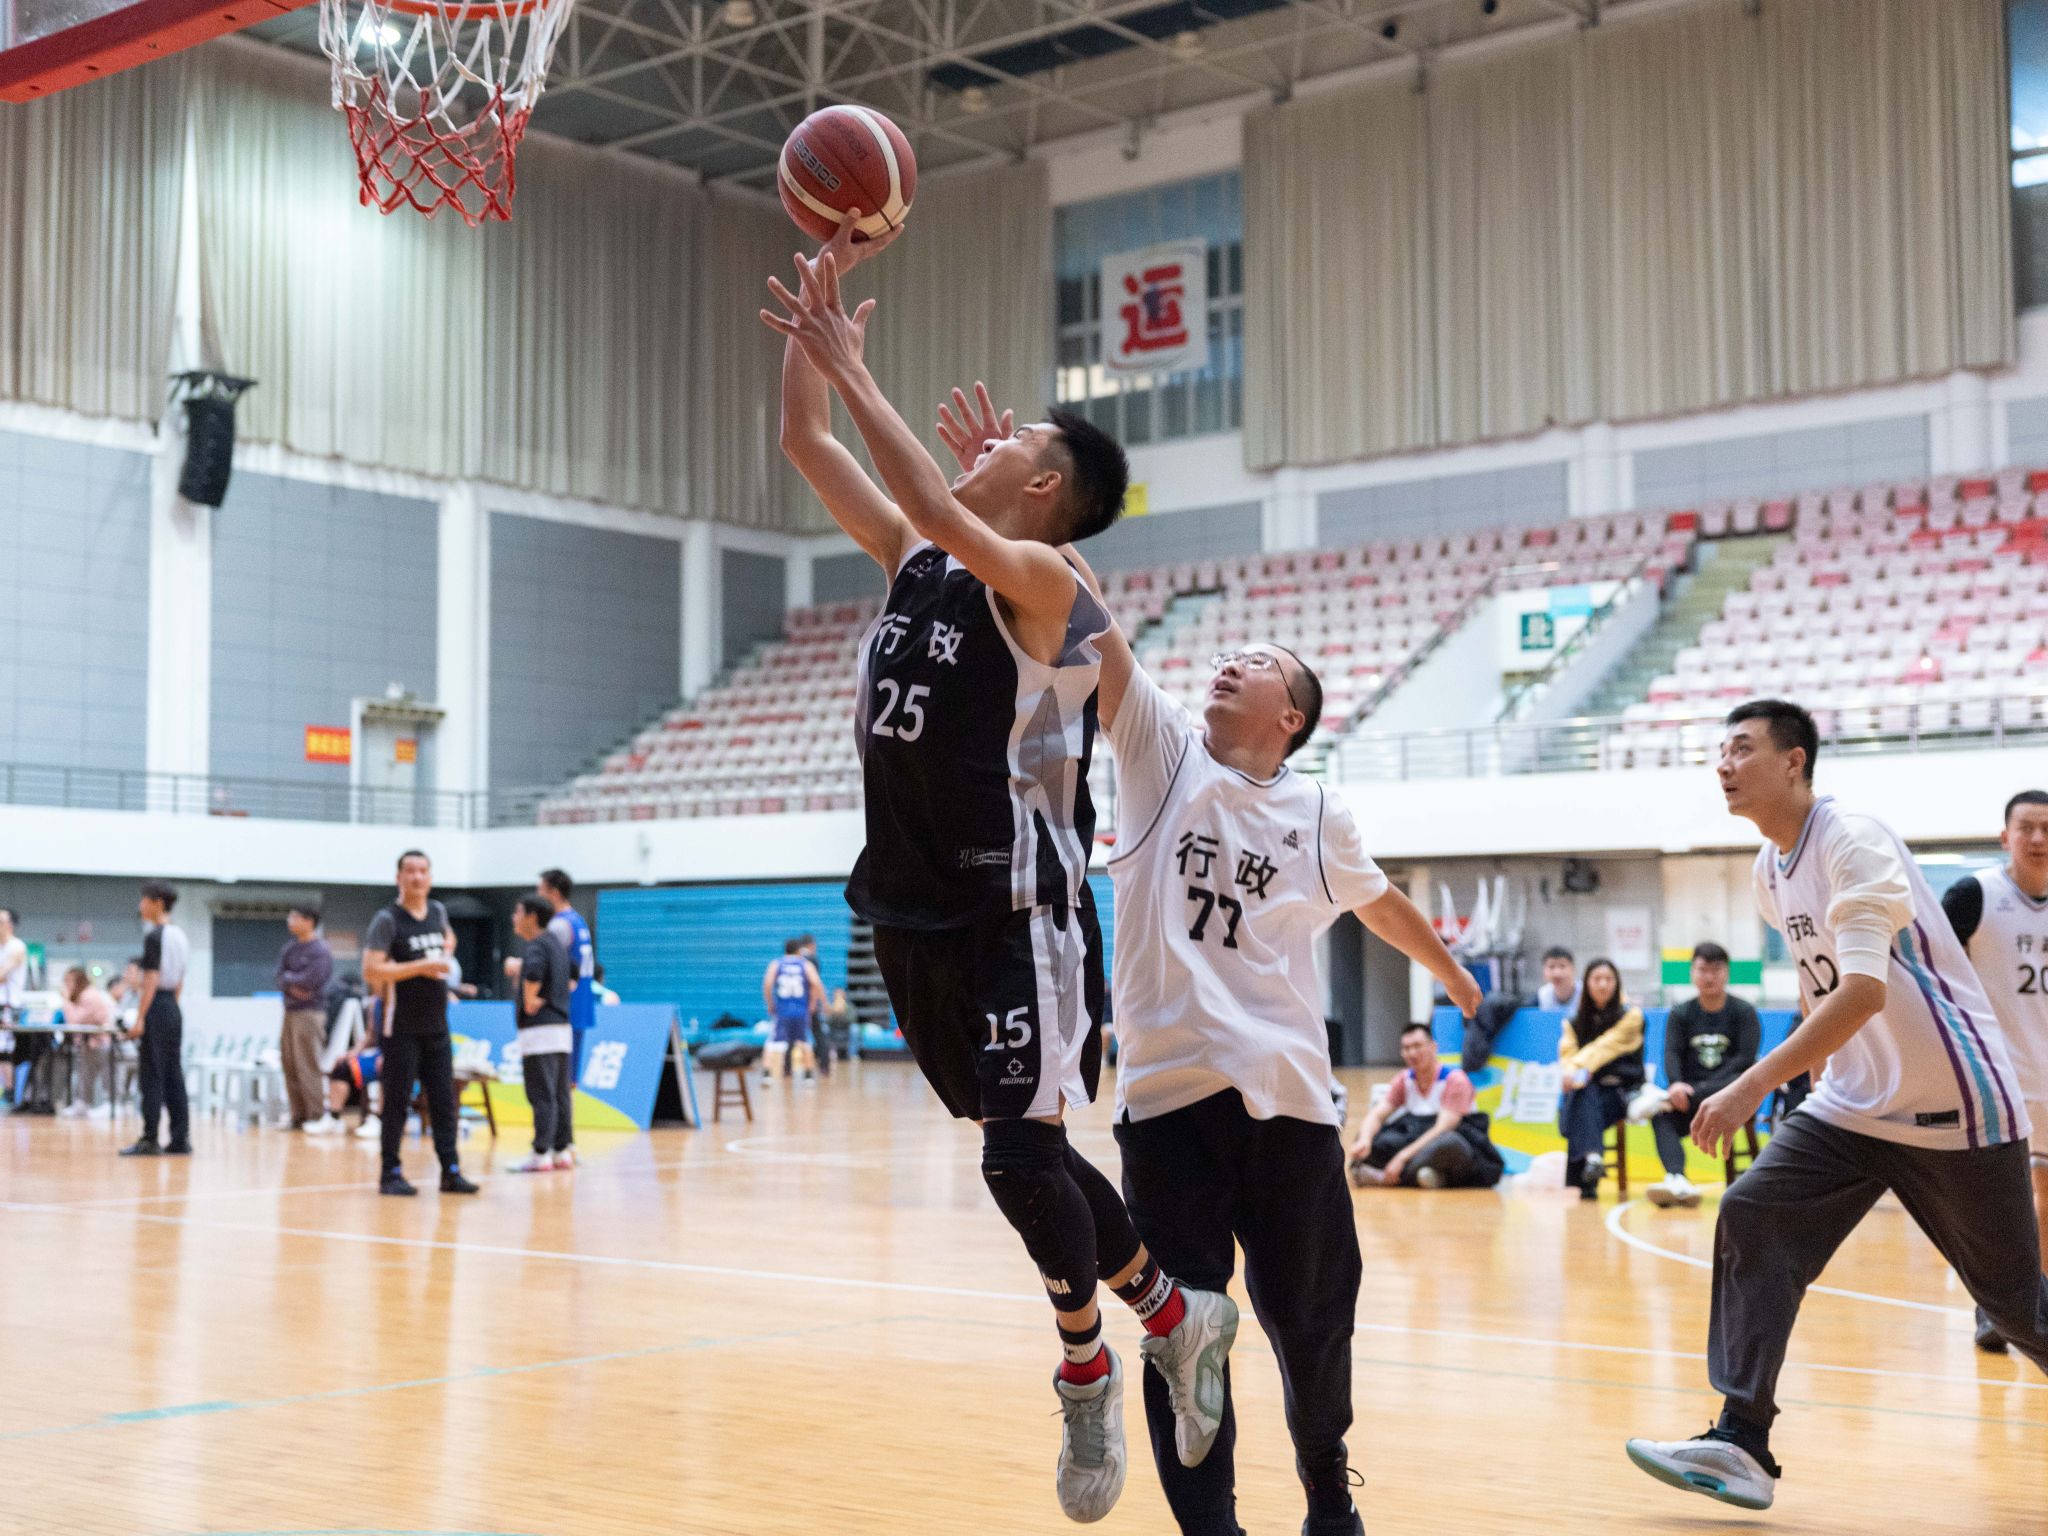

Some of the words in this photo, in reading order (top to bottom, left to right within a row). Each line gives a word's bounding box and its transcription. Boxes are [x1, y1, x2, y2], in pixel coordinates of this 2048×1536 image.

[1120, 264, 1188, 354] 运
[876, 612, 964, 666] 行政
[872, 678, 931, 743] 25
[1176, 830, 1279, 900] 行政
[1187, 885, 1243, 949] 77
[1785, 913, 1818, 943] 行政
